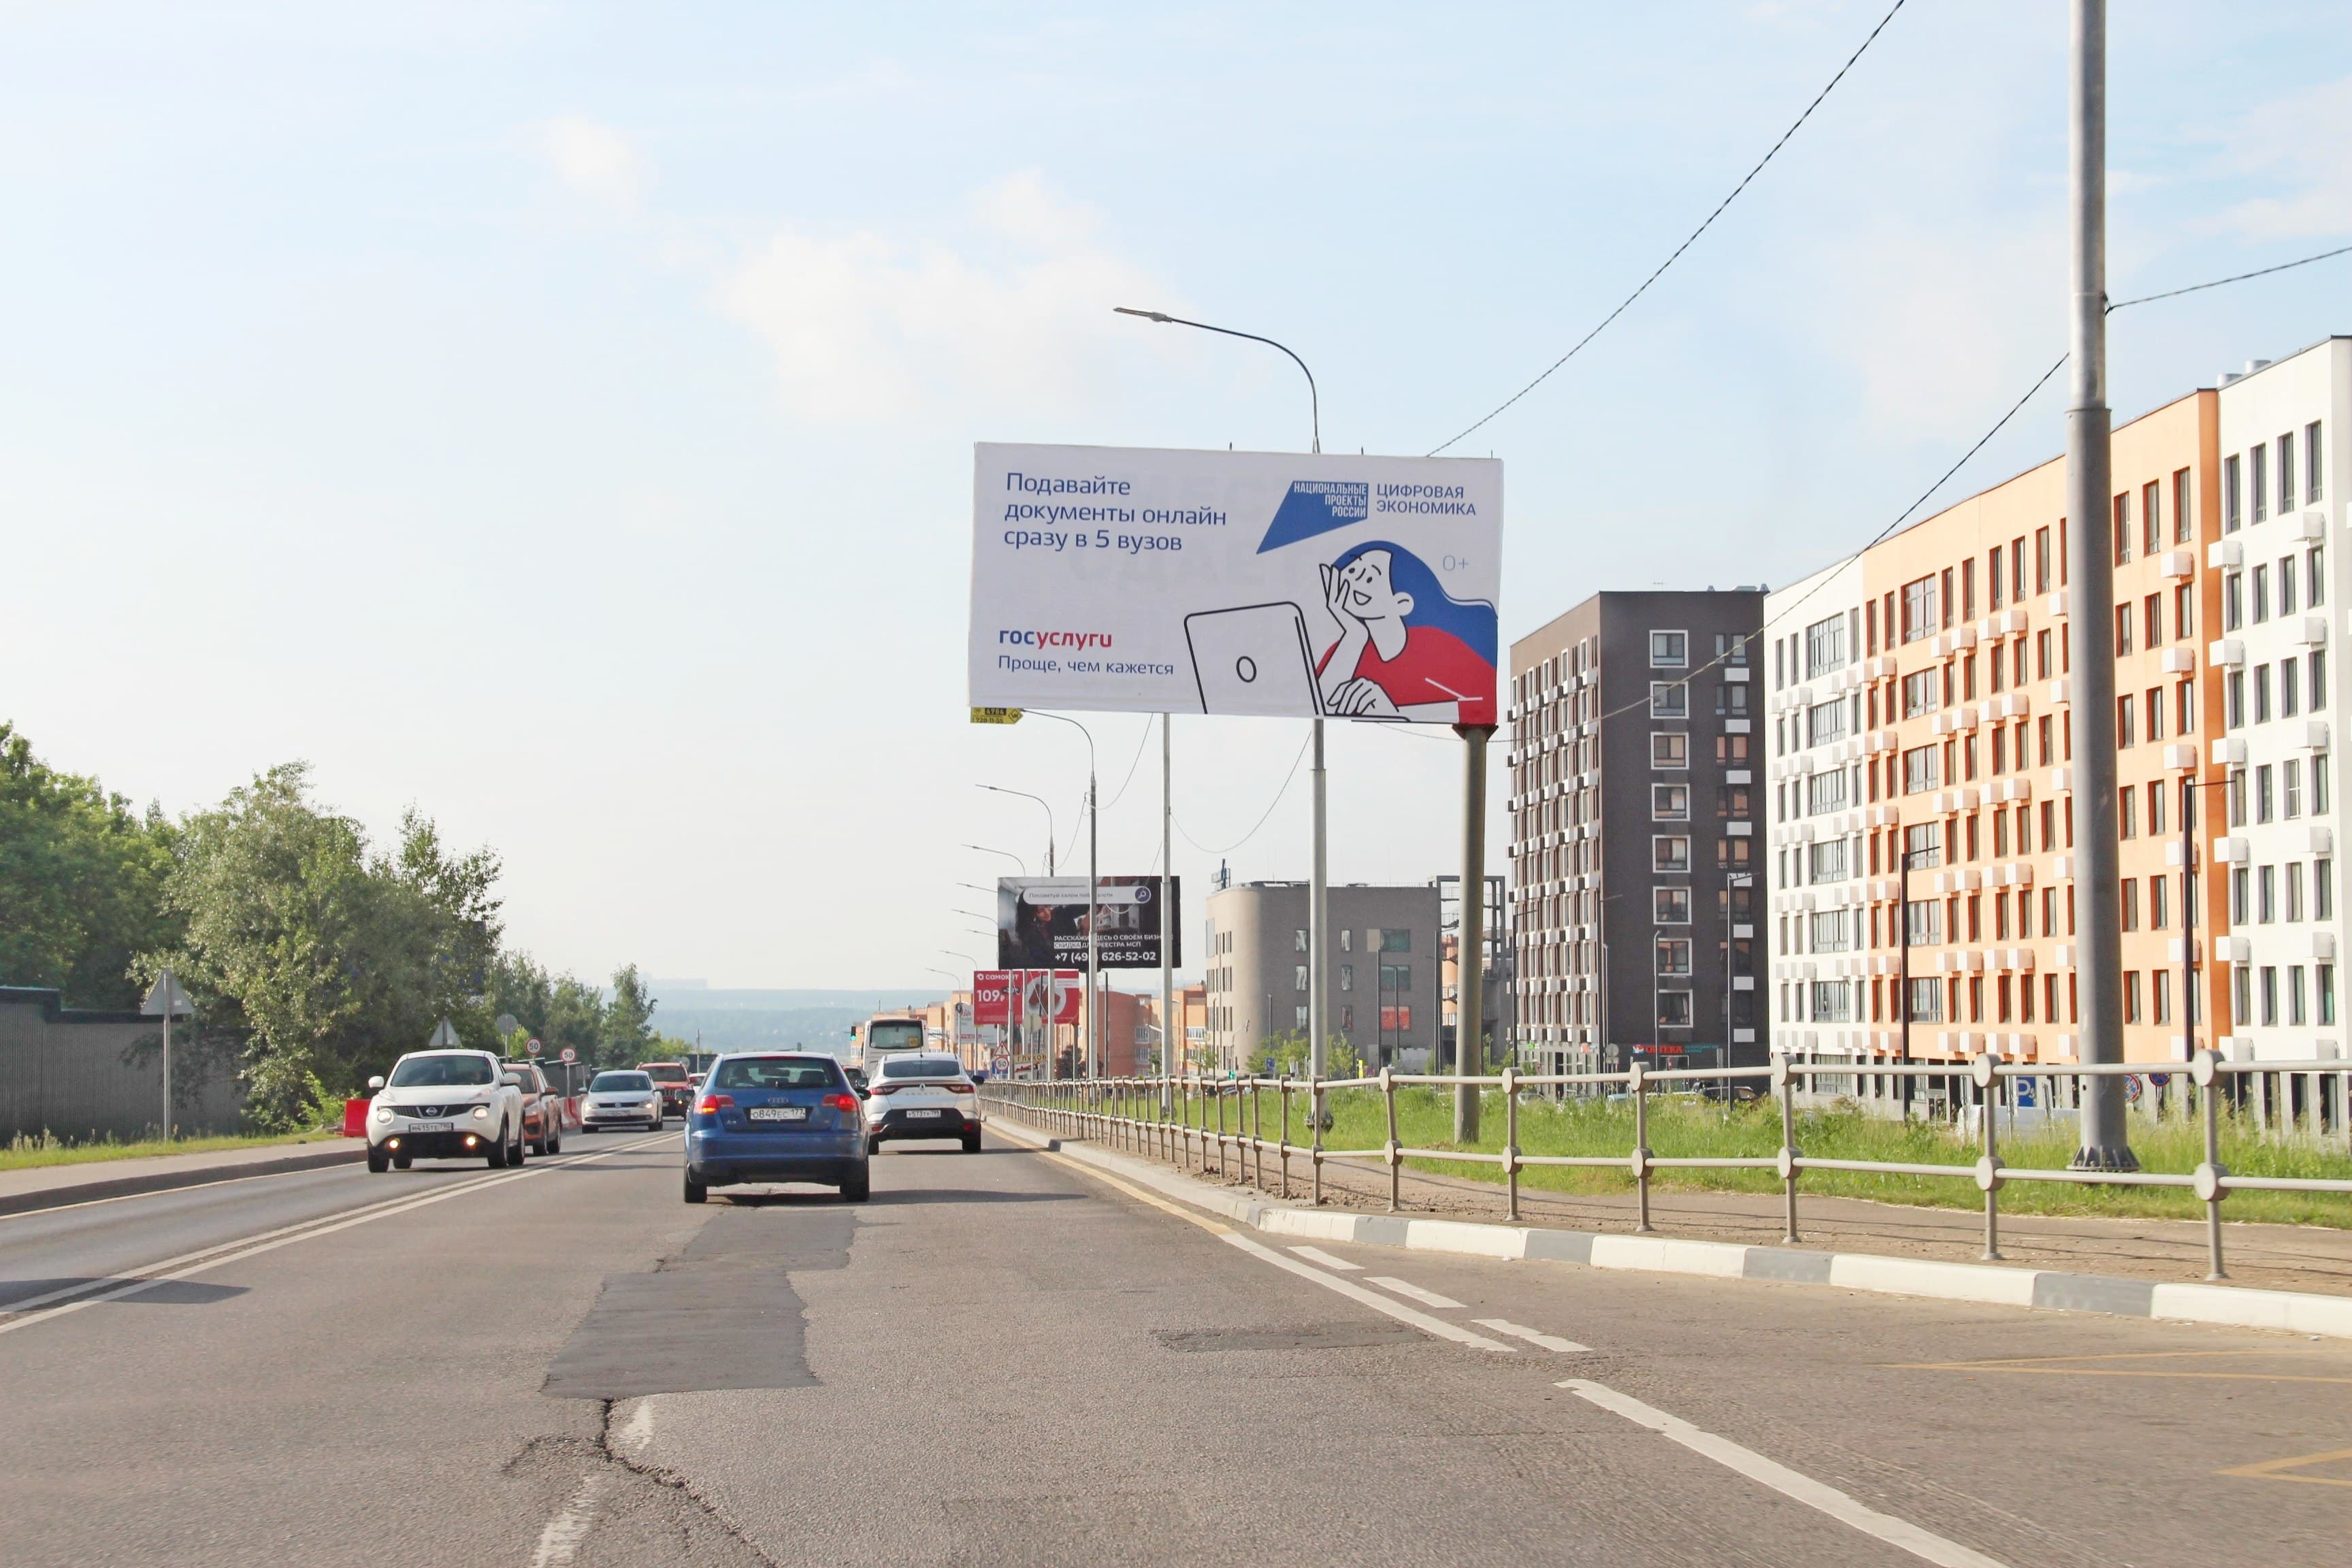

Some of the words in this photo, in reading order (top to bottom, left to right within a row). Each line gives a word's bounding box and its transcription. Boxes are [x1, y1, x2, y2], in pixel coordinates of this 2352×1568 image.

[1007, 472, 1131, 495] Подавайте
[1293, 482, 1367, 495] НАЦИОНАЛЬНЫЕ
[1377, 483, 1465, 499] ЦИФРОВАЯ
[1324, 495, 1367, 506] ПРОЕКТЫ
[1376, 500, 1476, 516] ЭКОНОМИКА
[1004, 504, 1134, 524] документы
[1143, 506, 1226, 525] онлайн
[1332, 506, 1366, 518] РОССИИ
[1004, 530, 1068, 552] сразу
[1075, 534, 1088, 547] в
[1095, 529, 1110, 549] 5
[1117, 534, 1182, 555] вузов
[1442, 555, 1469, 572] 0+
[999, 630, 1112, 651] госуслуги
[998, 655, 1061, 673] Проще,
[1067, 661, 1100, 672] чем
[1106, 662, 1174, 675] кажется
[1055, 953, 1067, 962] +7
[1102, 951, 1156, 961] 626-52-02
[2015, 1079, 2031, 1096] P
